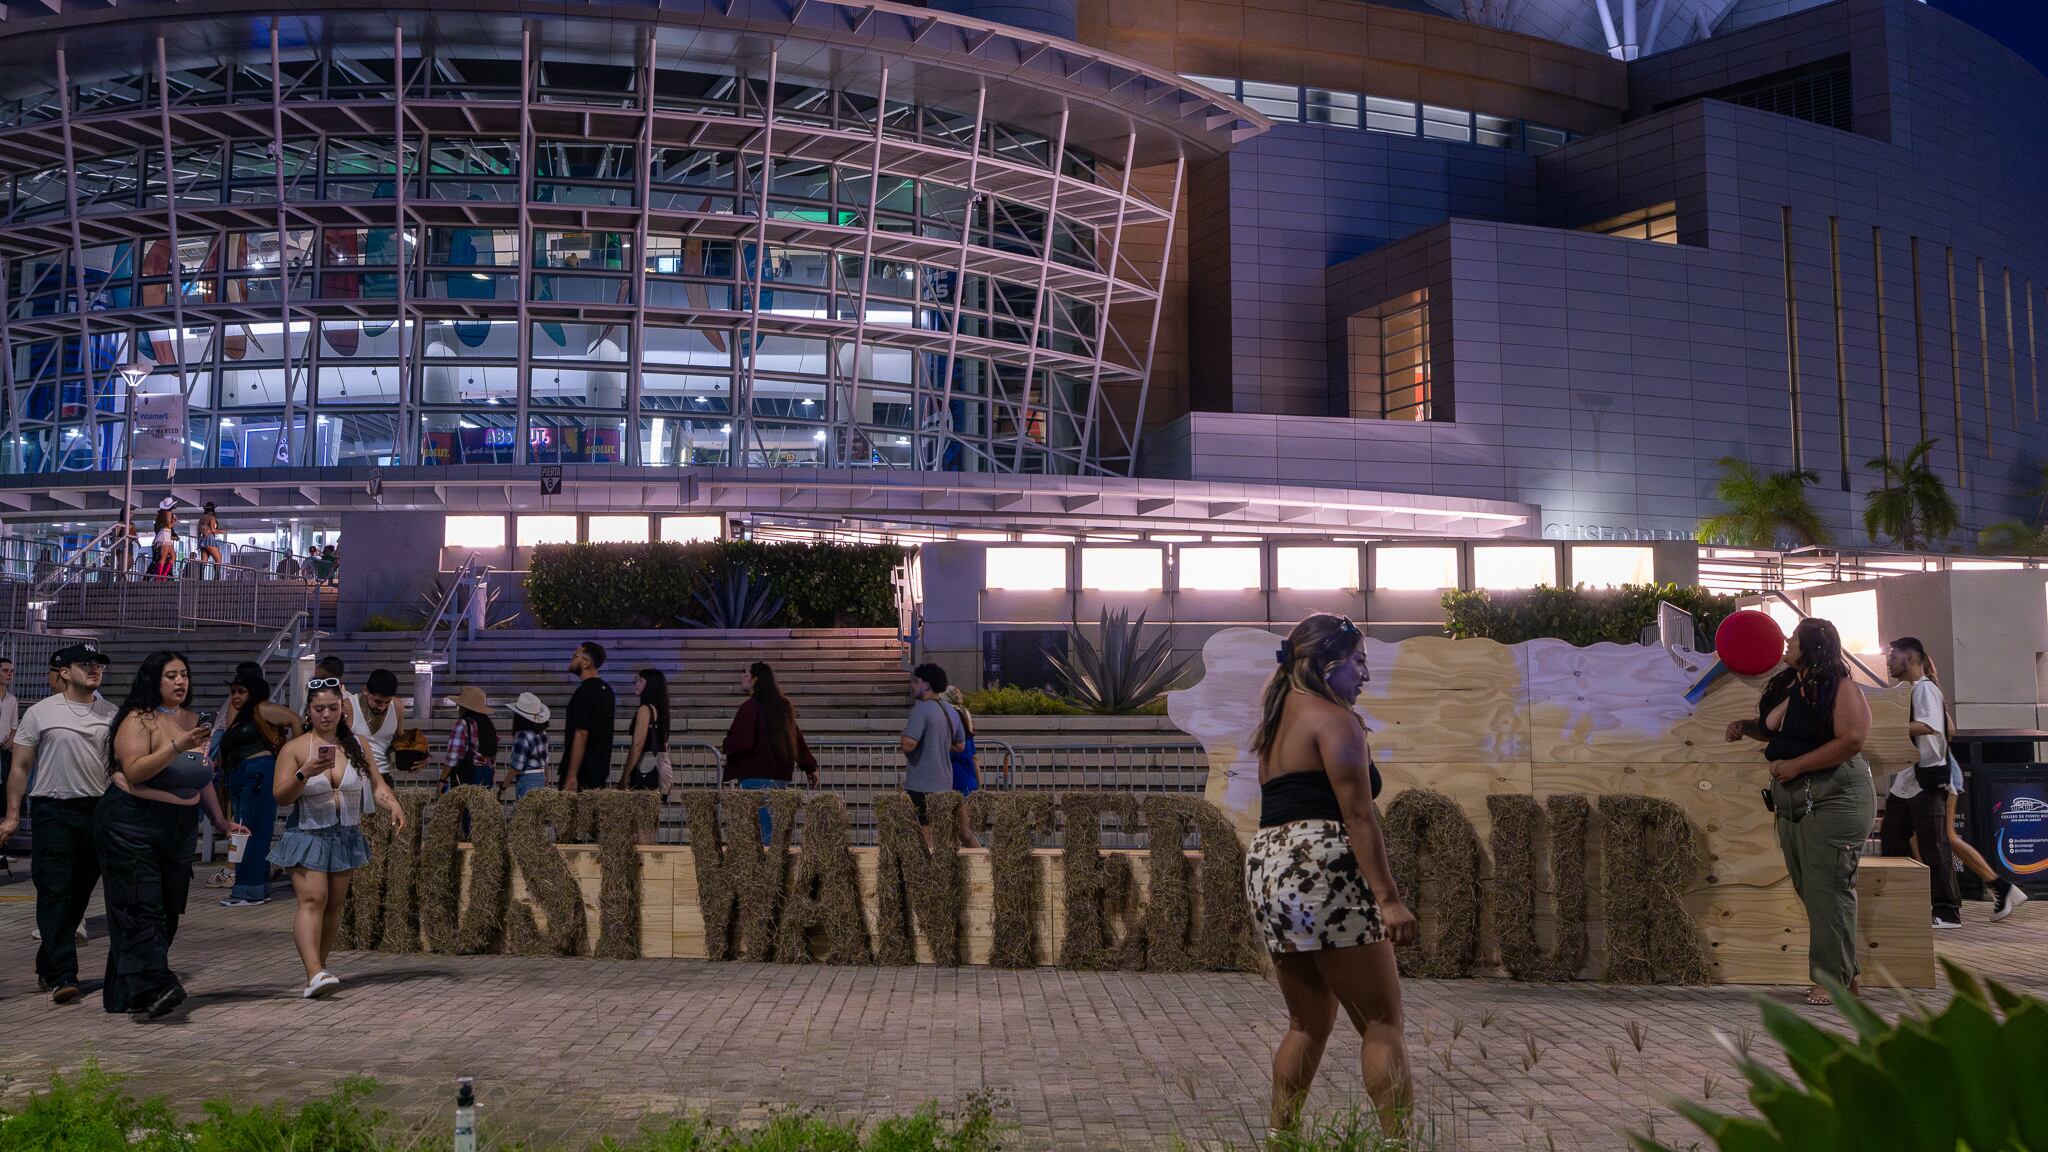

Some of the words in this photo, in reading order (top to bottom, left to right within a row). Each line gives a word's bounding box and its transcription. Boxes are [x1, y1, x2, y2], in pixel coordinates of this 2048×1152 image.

[139, 412, 169, 420] Walmart
[423, 447, 450, 459] SOLUT.
[541, 466, 561, 477] PUERTA
[547, 478, 554, 489] 8
[680, 786, 1264, 974] WANTED
[1374, 786, 1712, 986] OUR
